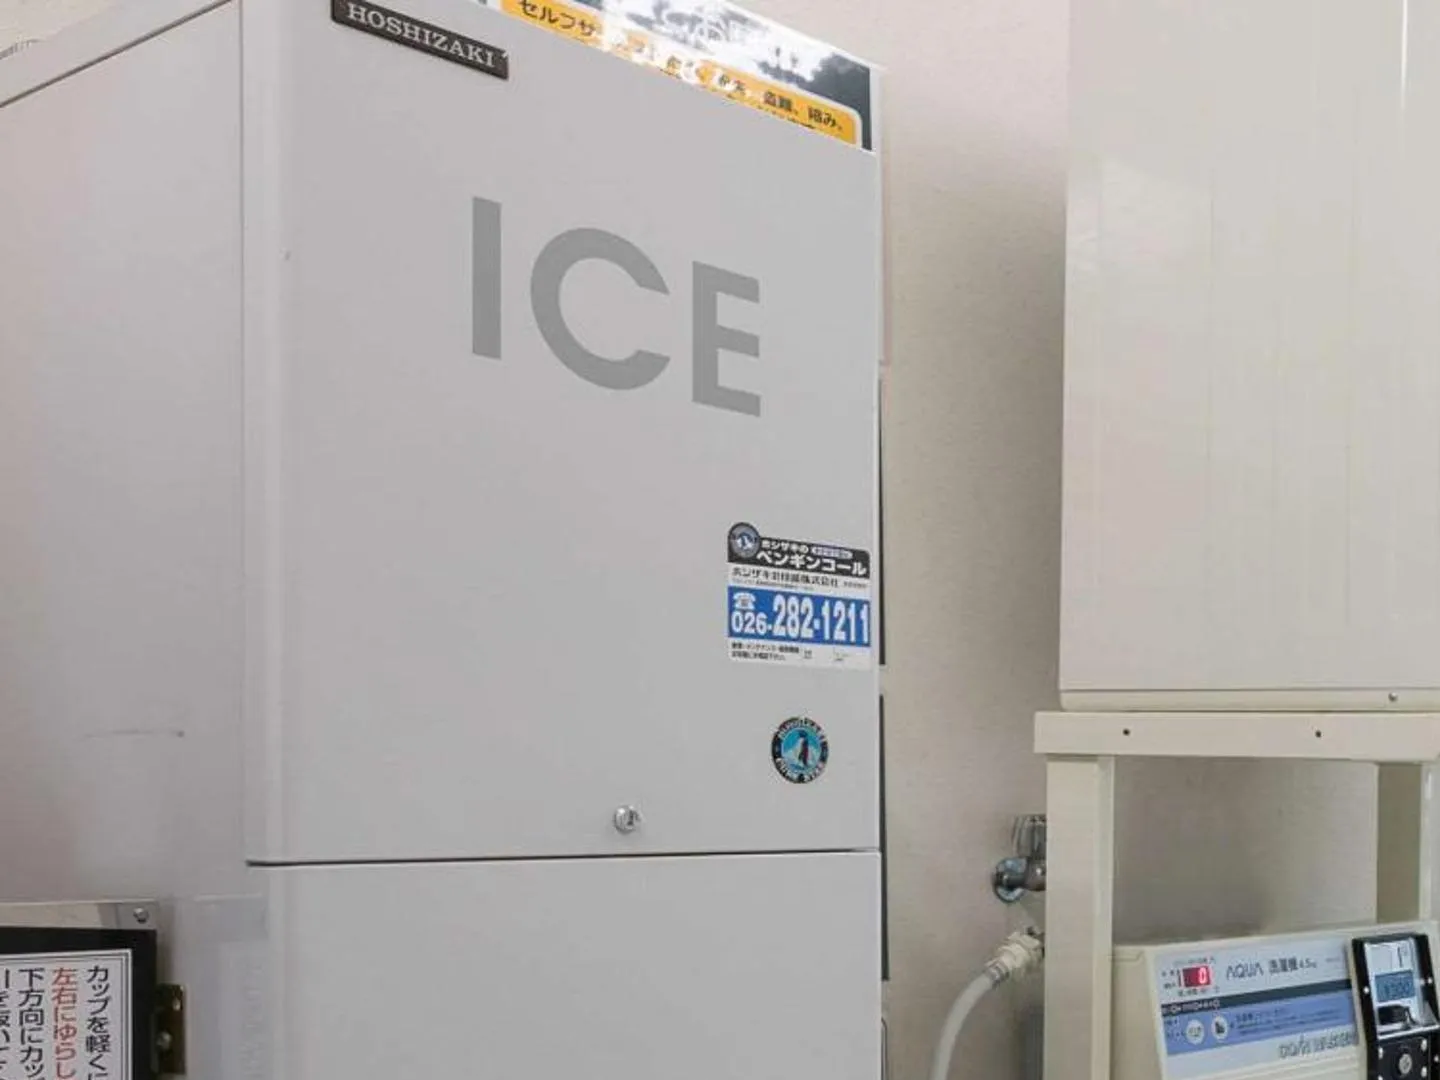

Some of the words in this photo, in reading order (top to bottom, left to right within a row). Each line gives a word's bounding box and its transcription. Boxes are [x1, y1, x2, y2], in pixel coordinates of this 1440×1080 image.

[348, 3, 495, 67] HOSHIZAKI
[472, 196, 760, 417] ICE
[1226, 961, 1264, 981] AQUA
